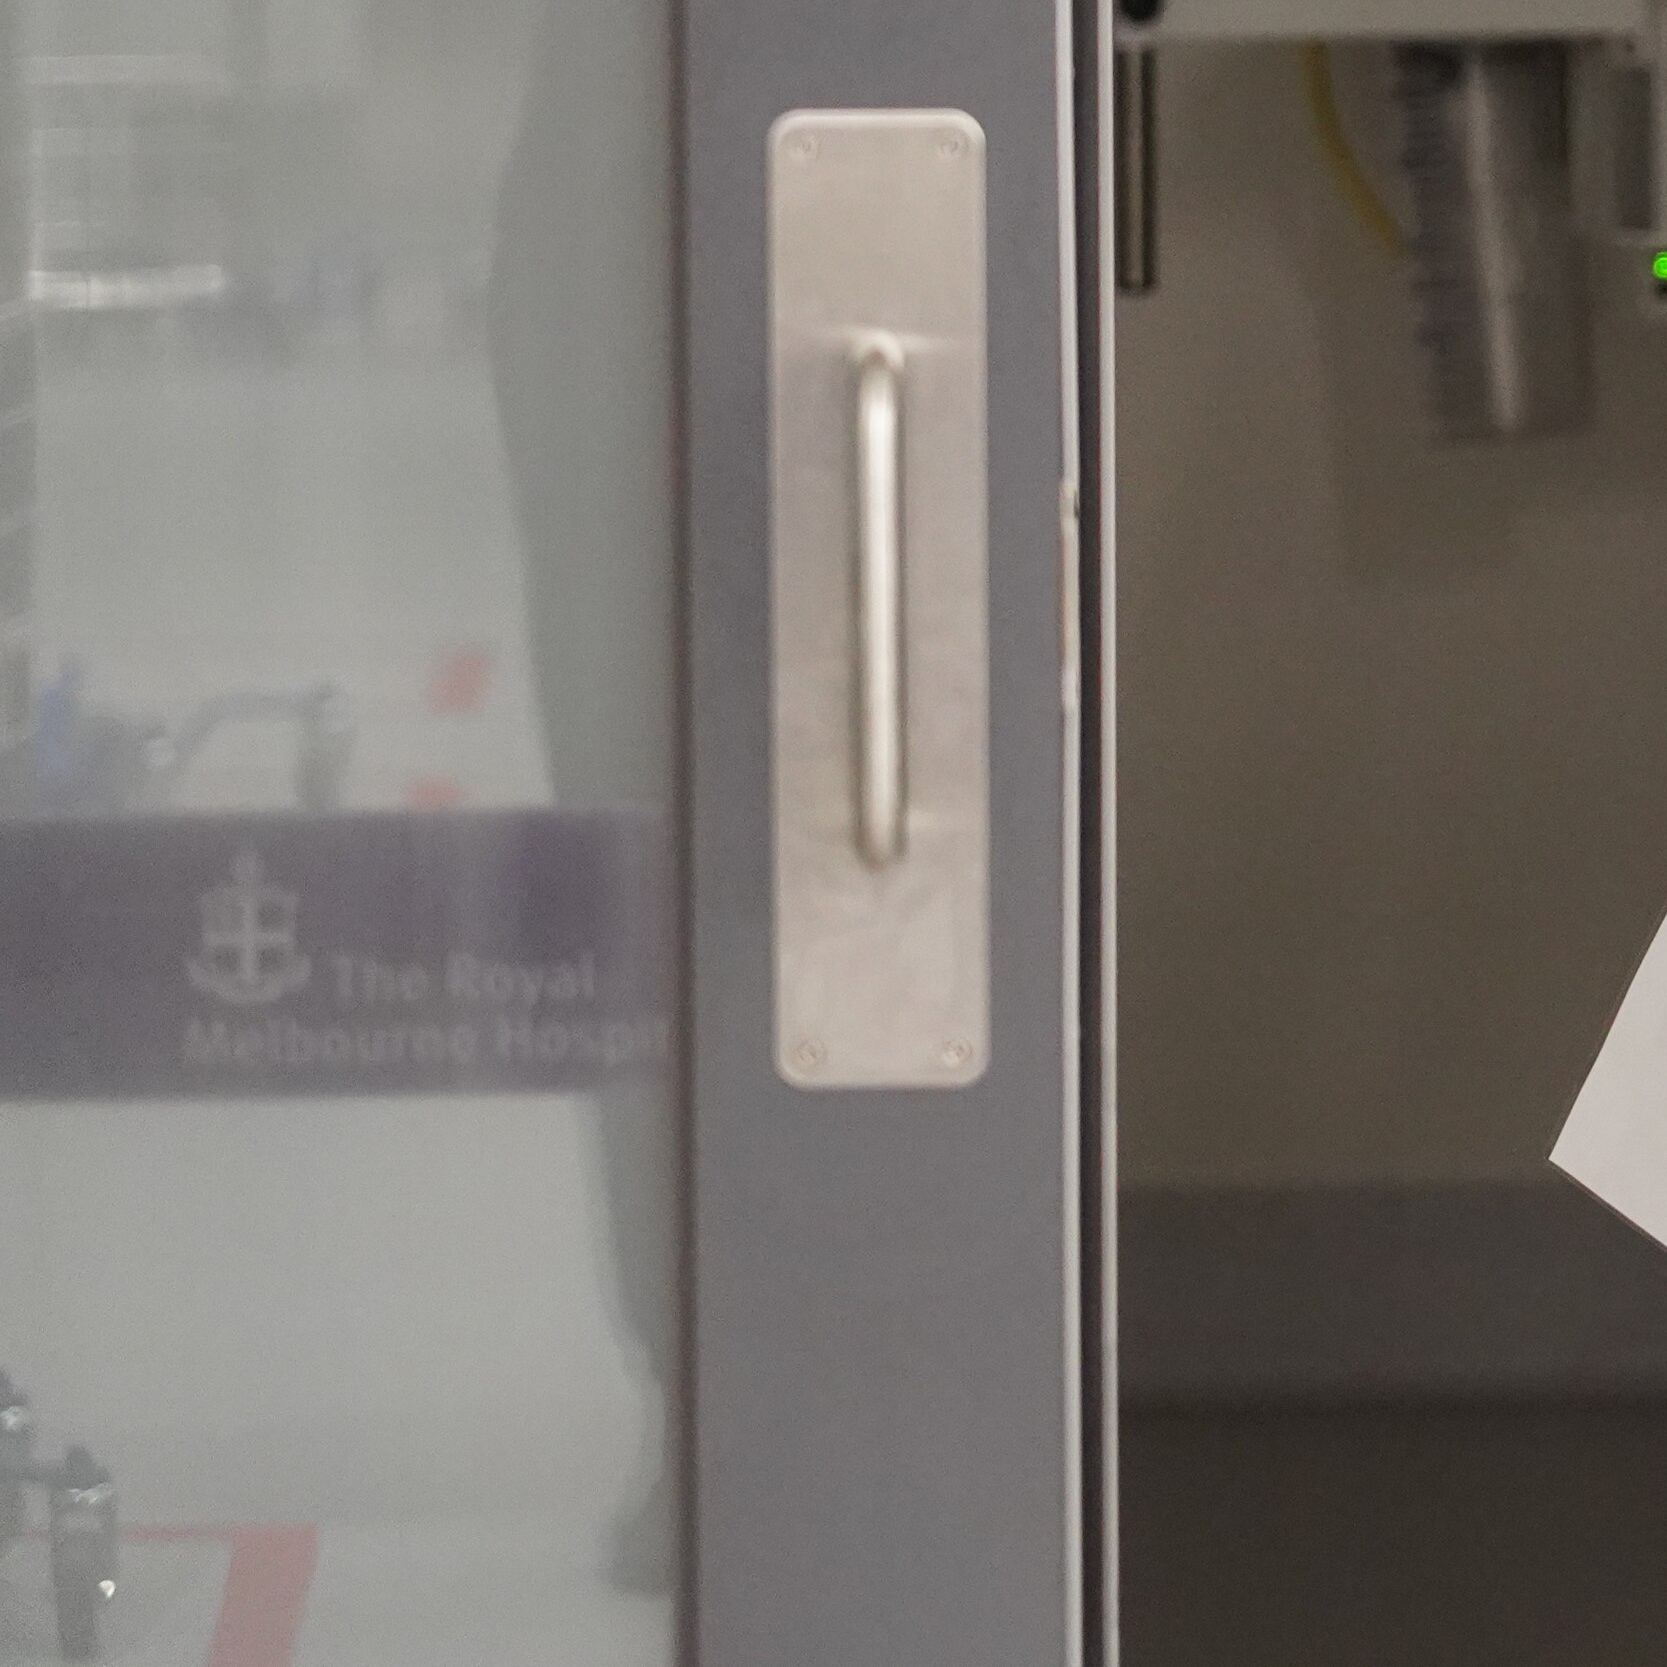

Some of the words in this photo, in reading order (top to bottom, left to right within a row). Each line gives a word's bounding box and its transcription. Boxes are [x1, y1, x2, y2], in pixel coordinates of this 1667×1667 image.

[330, 951, 430, 1004] The
[446, 950, 595, 1008] Royal
[182, 1017, 480, 1065] Melbourne
